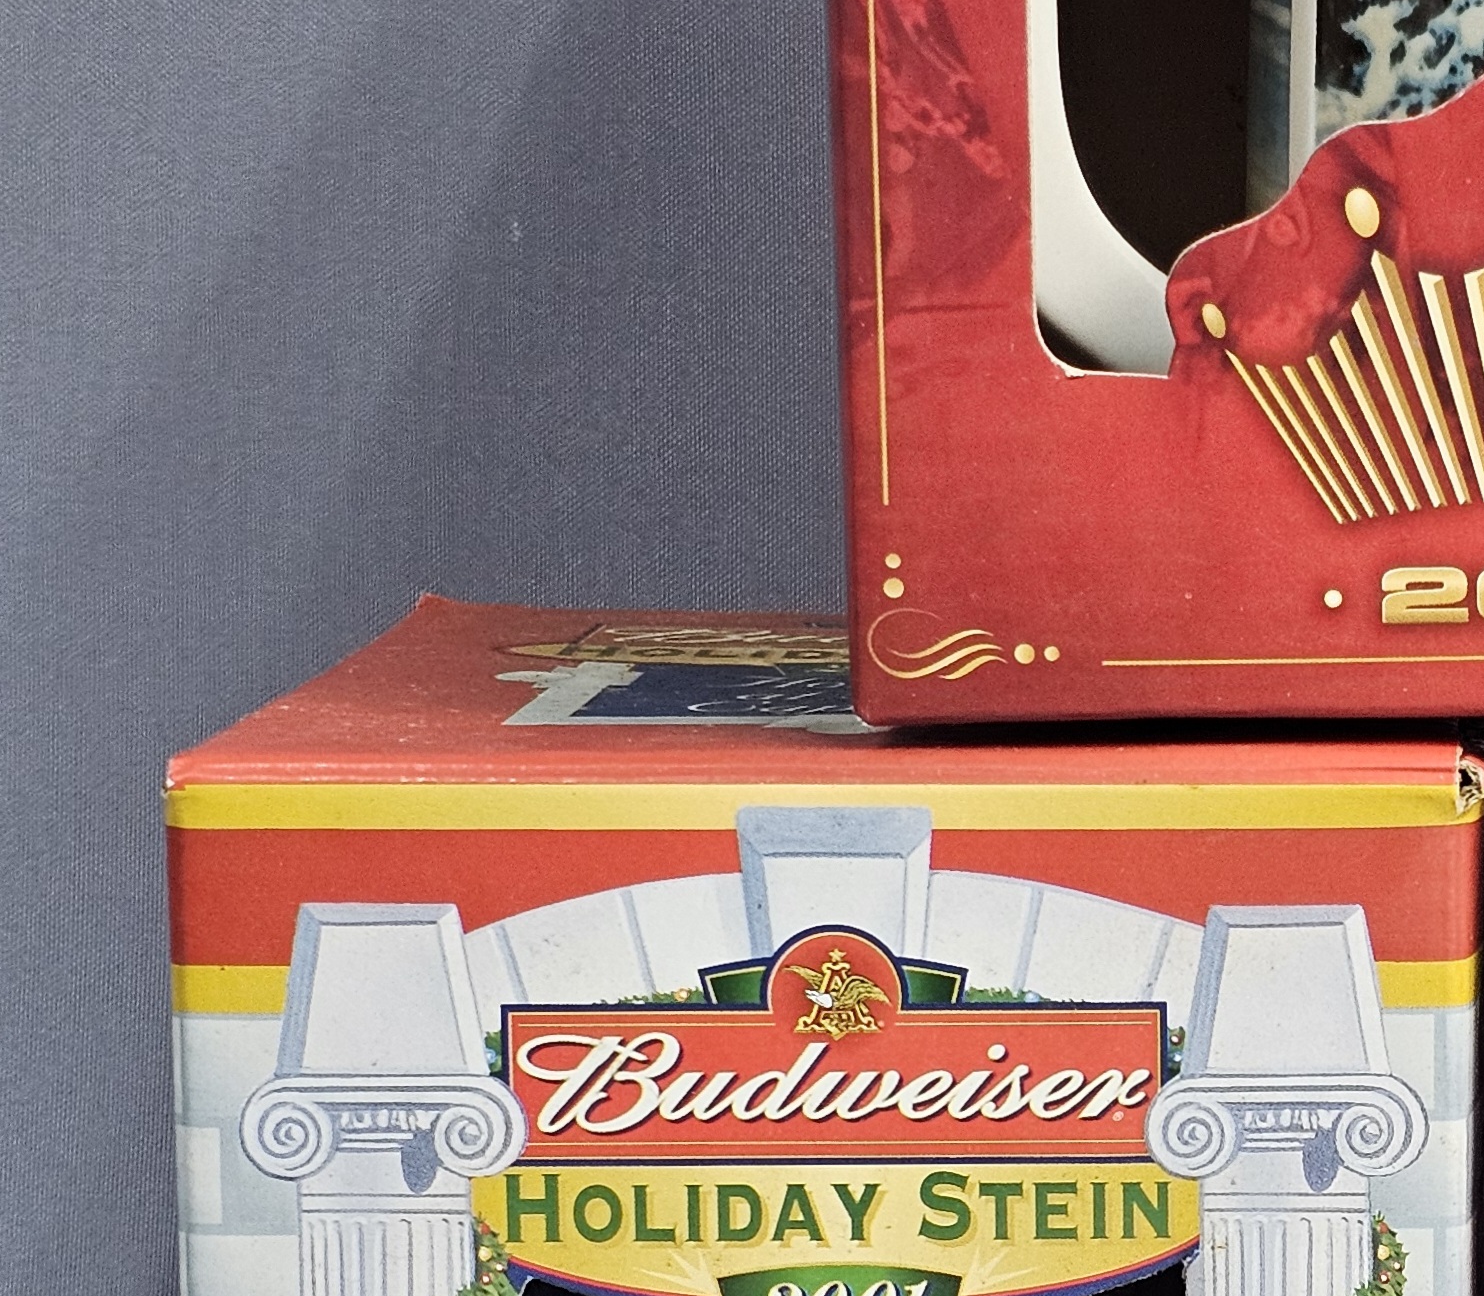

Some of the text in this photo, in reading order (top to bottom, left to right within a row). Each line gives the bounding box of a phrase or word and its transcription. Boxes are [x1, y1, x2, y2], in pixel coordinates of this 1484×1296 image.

[516, 1031, 1152, 1137] Budweiser
[504, 1170, 1173, 1247] HOLIDAY STEIN
